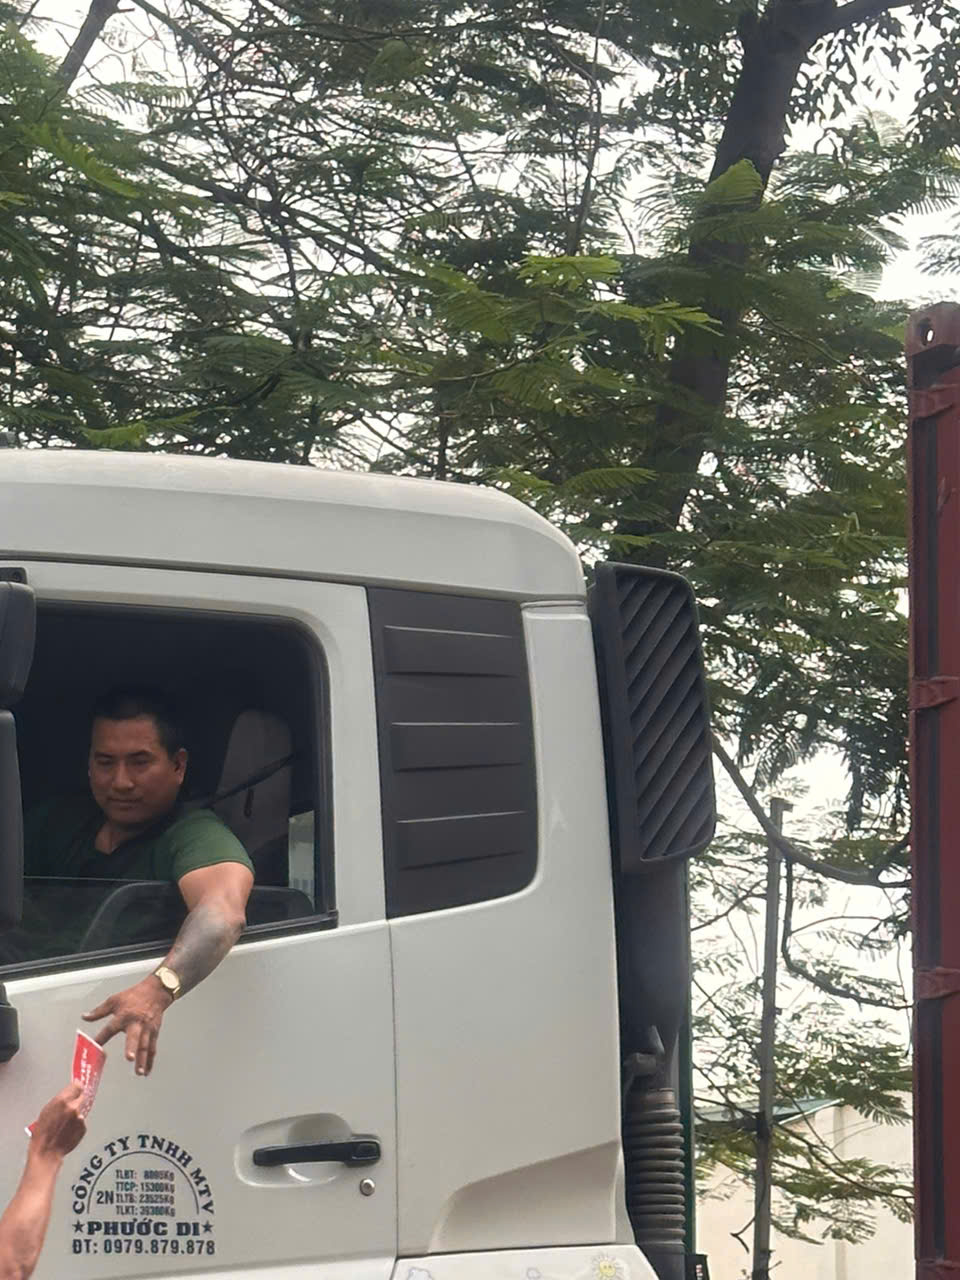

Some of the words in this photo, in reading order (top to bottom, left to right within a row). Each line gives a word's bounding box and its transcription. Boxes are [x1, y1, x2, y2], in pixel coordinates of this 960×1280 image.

[72, 1155, 103, 1215] CÔNG
[104, 1136, 130, 1157] TY
[138, 1134, 193, 1168] TNHH
[190, 1168, 215, 1215] MTV
[96, 1190, 115, 1205] 2N
[87, 1217, 168, 1237] PHƯỚC
[176, 1222, 201, 1237] DI
[103, 1239, 215, 1256] 0979.879.878
